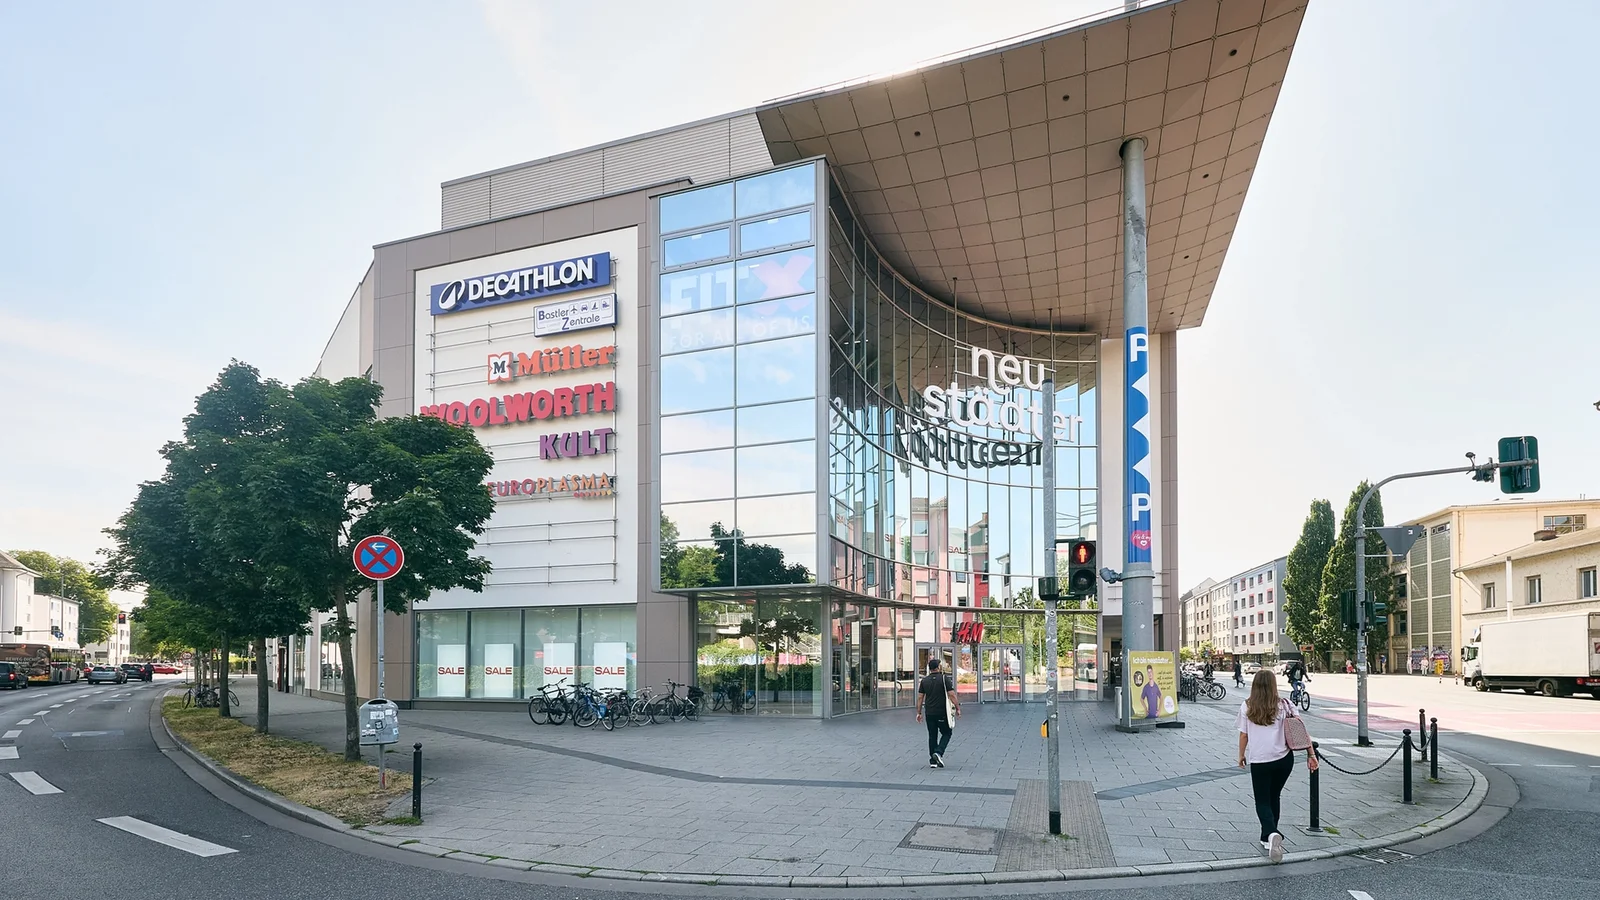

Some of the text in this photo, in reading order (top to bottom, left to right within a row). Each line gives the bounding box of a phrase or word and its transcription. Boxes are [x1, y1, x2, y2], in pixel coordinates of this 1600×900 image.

[468, 257, 594, 301] DECATHLON
[538, 308, 570, 321] Bastler
[561, 313, 600, 331] Zentrale
[671, 333, 704, 350] FOR
[752, 321, 779, 338] OF
[787, 315, 811, 333] US
[516, 344, 615, 377] Müller
[1130, 333, 1149, 363] P
[493, 360, 506, 374] M
[971, 346, 1045, 396] neu
[420, 381, 615, 427] WOOLWORTH
[921, 382, 1083, 443] städter
[539, 427, 613, 461] KULT
[487, 472, 611, 497] EUROPLASMA
[1131, 492, 1151, 522] P
[438, 667, 465, 675] SALE
[485, 667, 513, 675] SALE
[544, 667, 574, 675] SALE
[594, 666, 625, 675] SALE
